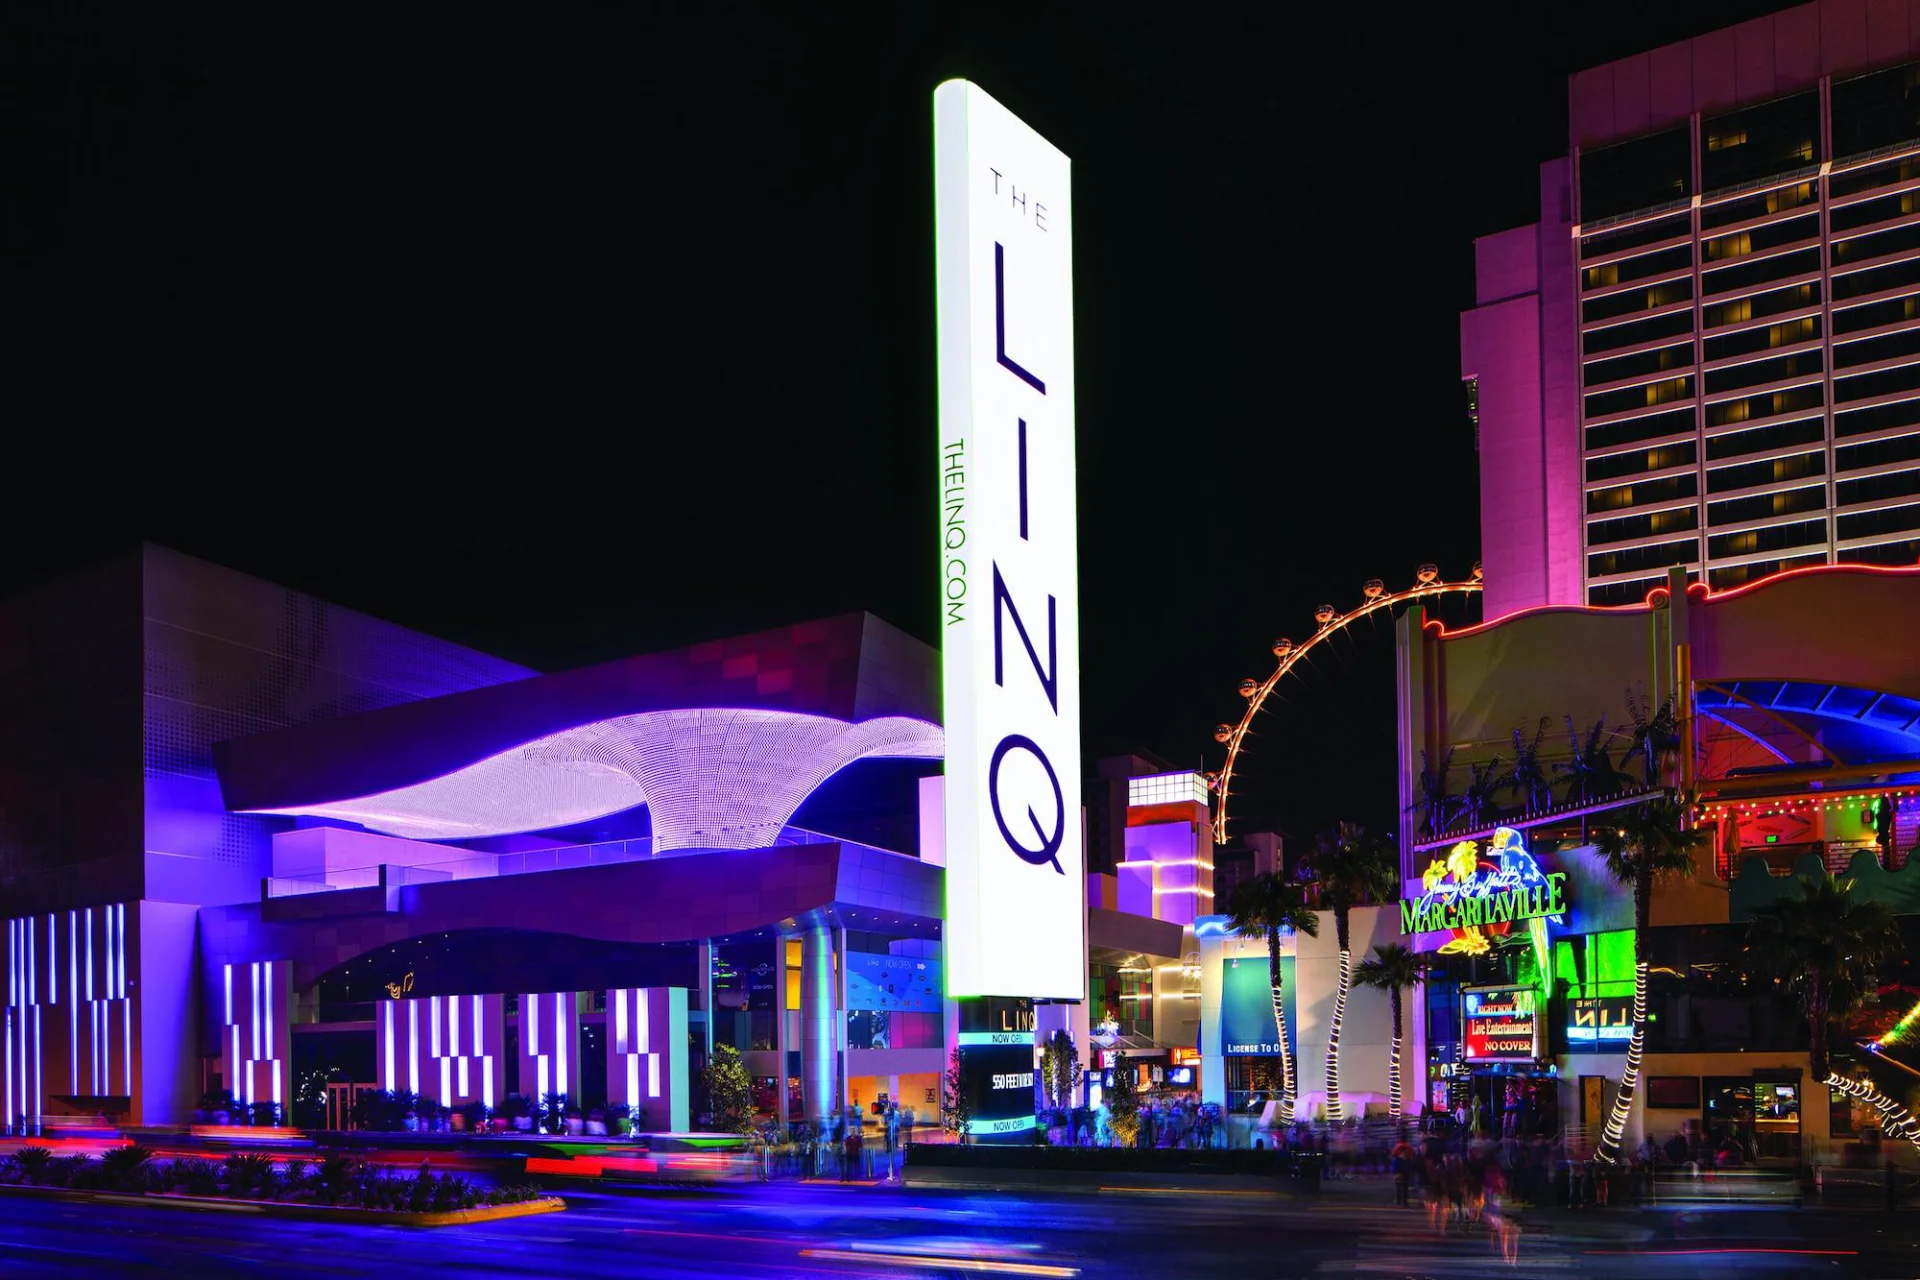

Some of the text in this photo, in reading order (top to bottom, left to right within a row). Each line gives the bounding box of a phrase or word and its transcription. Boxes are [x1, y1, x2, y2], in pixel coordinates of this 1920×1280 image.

[990, 167, 1047, 232] THE
[944, 437, 967, 627] THELINQ.COM
[989, 240, 1066, 876] LINQ
[1398, 872, 1567, 935] MARGARITAVILLE
[1498, 1004, 1514, 1013] NOW
[1002, 1010, 1035, 1031] LINQ
[1472, 1018, 1533, 1035] Live Entertainment
[992, 1034, 1009, 1043] NOW
[1485, 1040, 1531, 1051] NO COVER
[993, 1121, 1011, 1131] NOW
